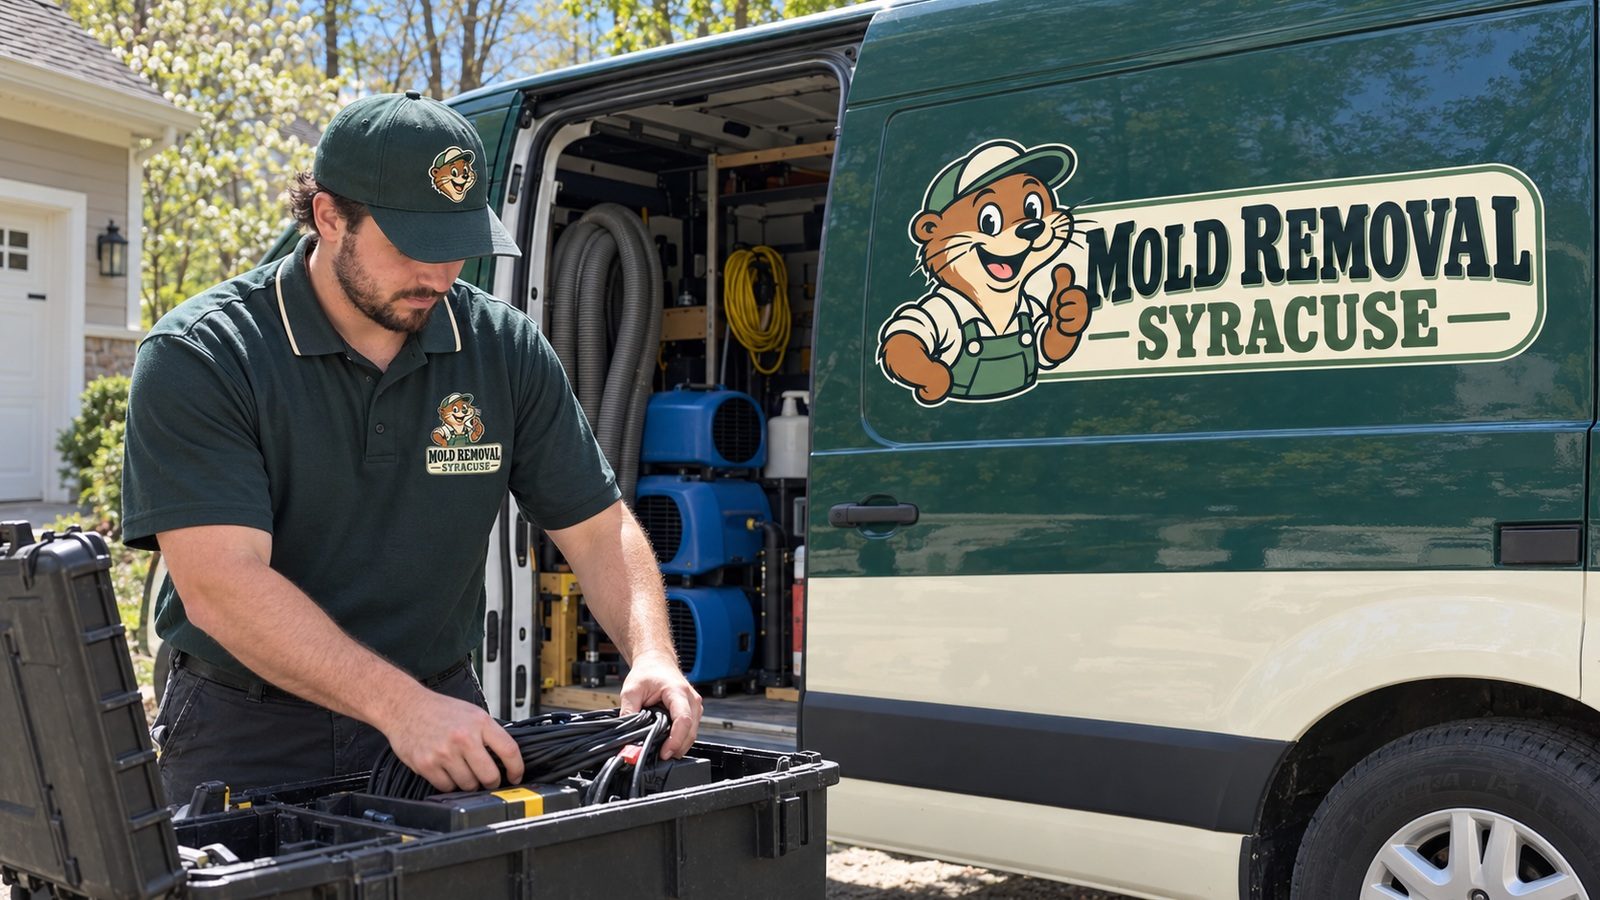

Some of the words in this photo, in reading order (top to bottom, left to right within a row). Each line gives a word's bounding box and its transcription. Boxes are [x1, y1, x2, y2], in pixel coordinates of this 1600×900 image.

[1086, 219, 1230, 307] MOLD
[1240, 196, 1533, 286] REMOVAL
[1138, 288, 1438, 360] SYRACUSE
[428, 450, 455, 464] MOLD
[457, 447, 500, 461] REMOVAL
[441, 462, 491, 472] SYRACUSE
